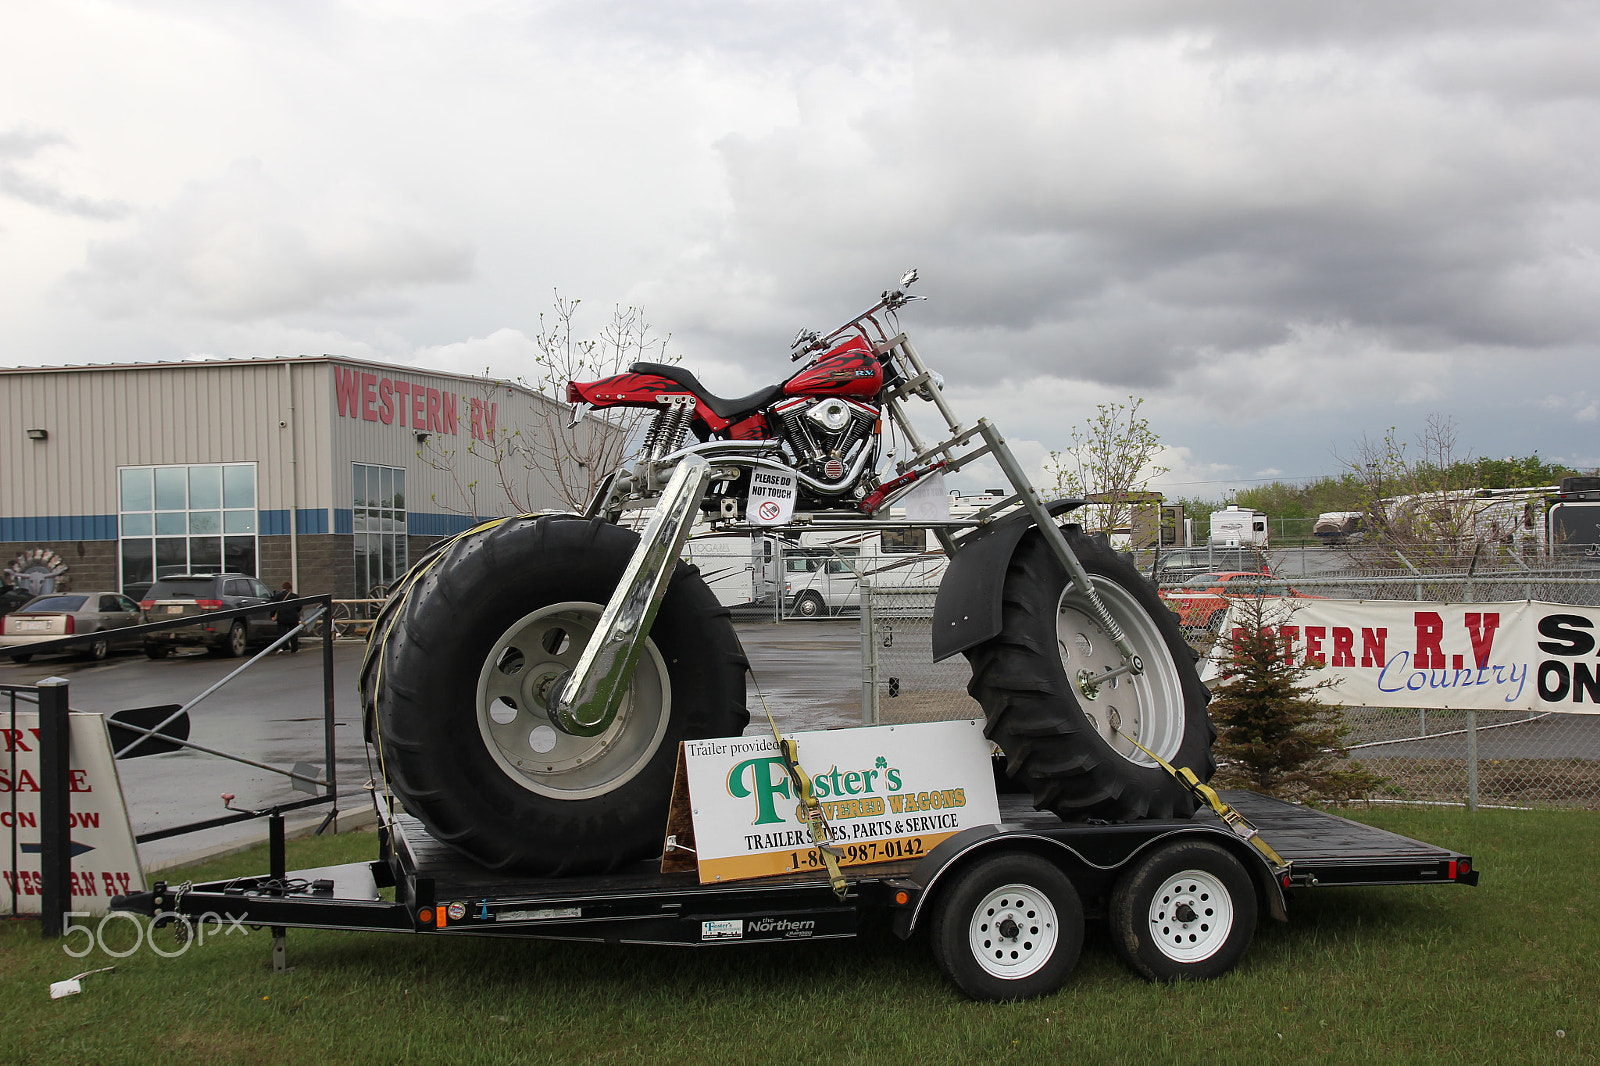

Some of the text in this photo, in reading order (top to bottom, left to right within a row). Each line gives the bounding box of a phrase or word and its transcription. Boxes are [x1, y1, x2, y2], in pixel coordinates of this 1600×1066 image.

[334, 366, 497, 442] WESTERN RV
[752, 486, 792, 499] NOT TOUCH
[755, 473, 791, 486] PLEASE DO
[1413, 611, 1500, 669] R.V
[1537, 613, 1600, 656] S
[1377, 650, 1527, 702] Country
[688, 742, 727, 757] Trailer
[0, 769, 92, 793] SAE
[1, 812, 37, 828] ON
[796, 788, 966, 824] CVERED WAGONS
[745, 830, 806, 850] TRAILER
[806, 825, 851, 846] SLES,
[852, 820, 892, 838] PARTS
[894, 819, 908, 833] &
[909, 813, 959, 831] SERVICE
[791, 837, 924, 870] 1-86-987-0142
[3, 870, 130, 896] WESRN RV
[748, 919, 815, 932] Northern
